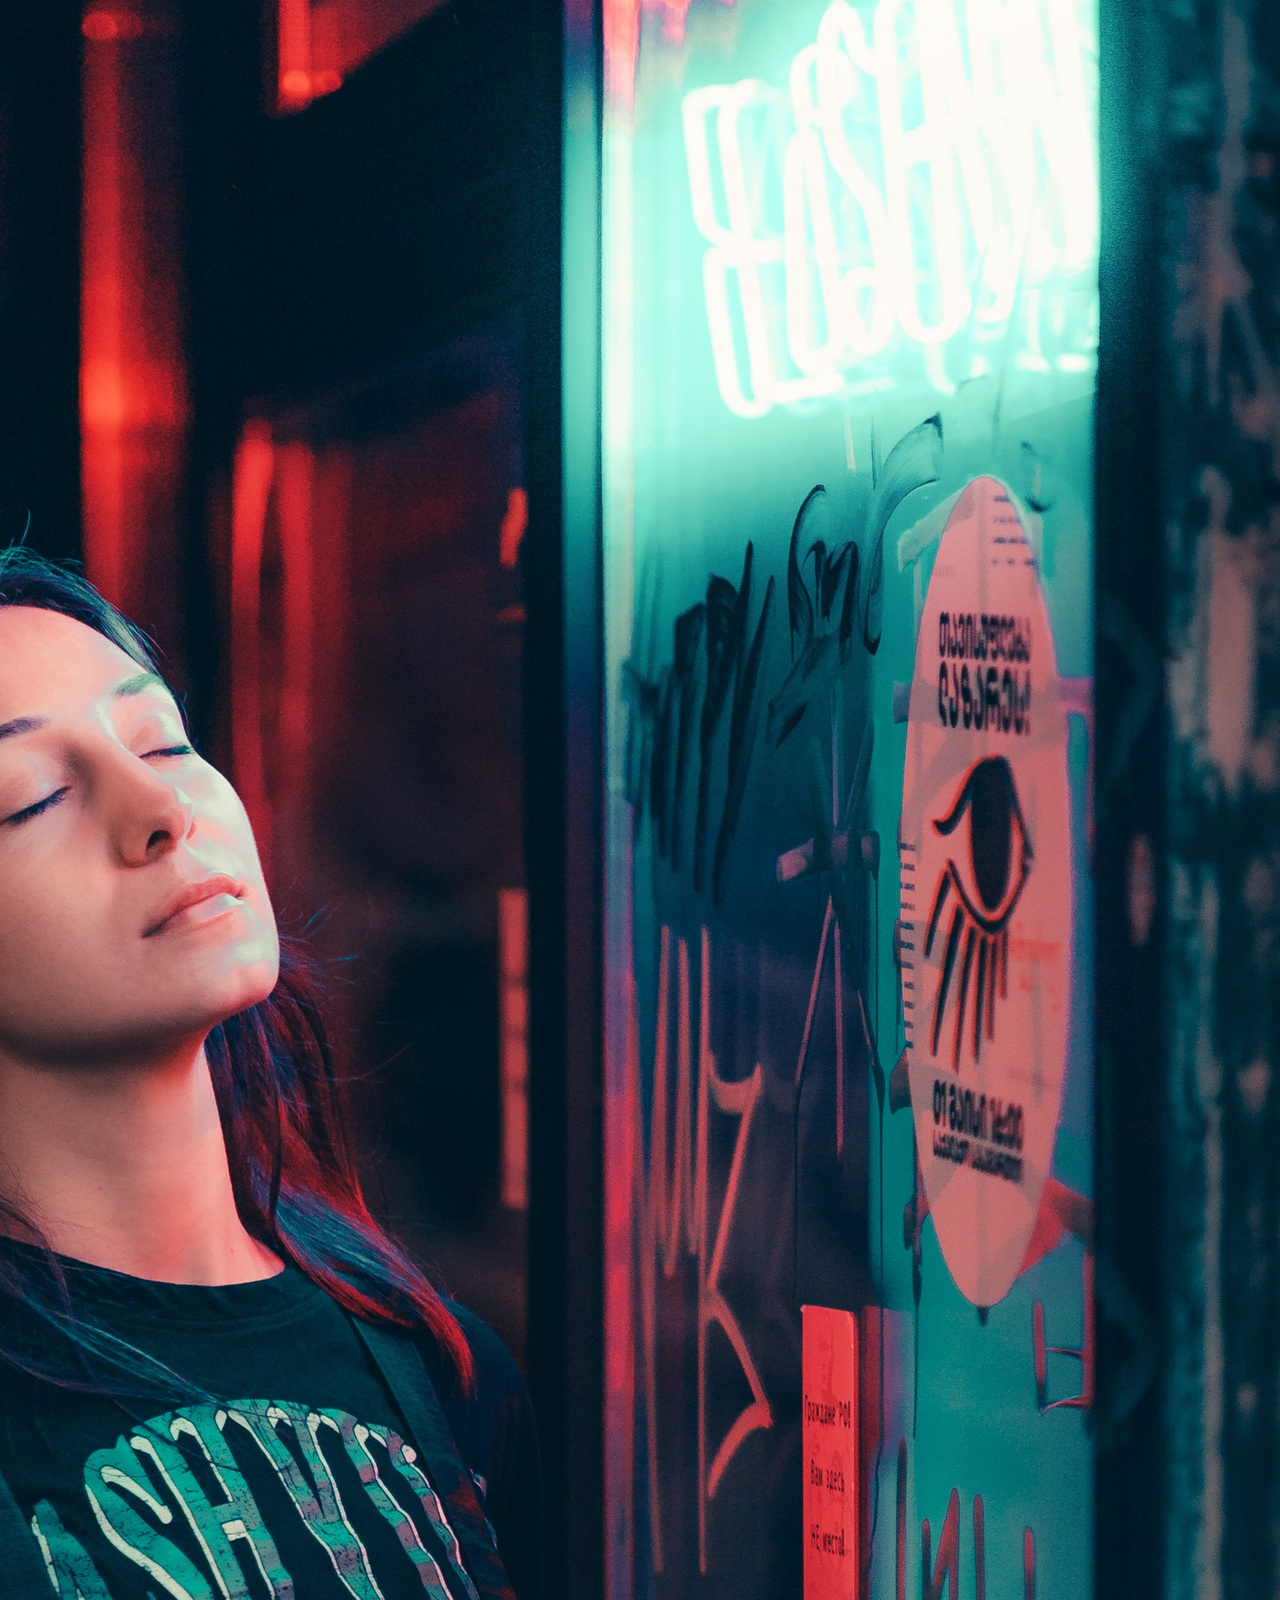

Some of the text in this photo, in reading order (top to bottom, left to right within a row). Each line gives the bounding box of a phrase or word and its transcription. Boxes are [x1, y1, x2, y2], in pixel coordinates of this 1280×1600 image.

[811, 1458, 845, 1494] Вам здесь
[811, 1523, 820, 1551] НЕ
